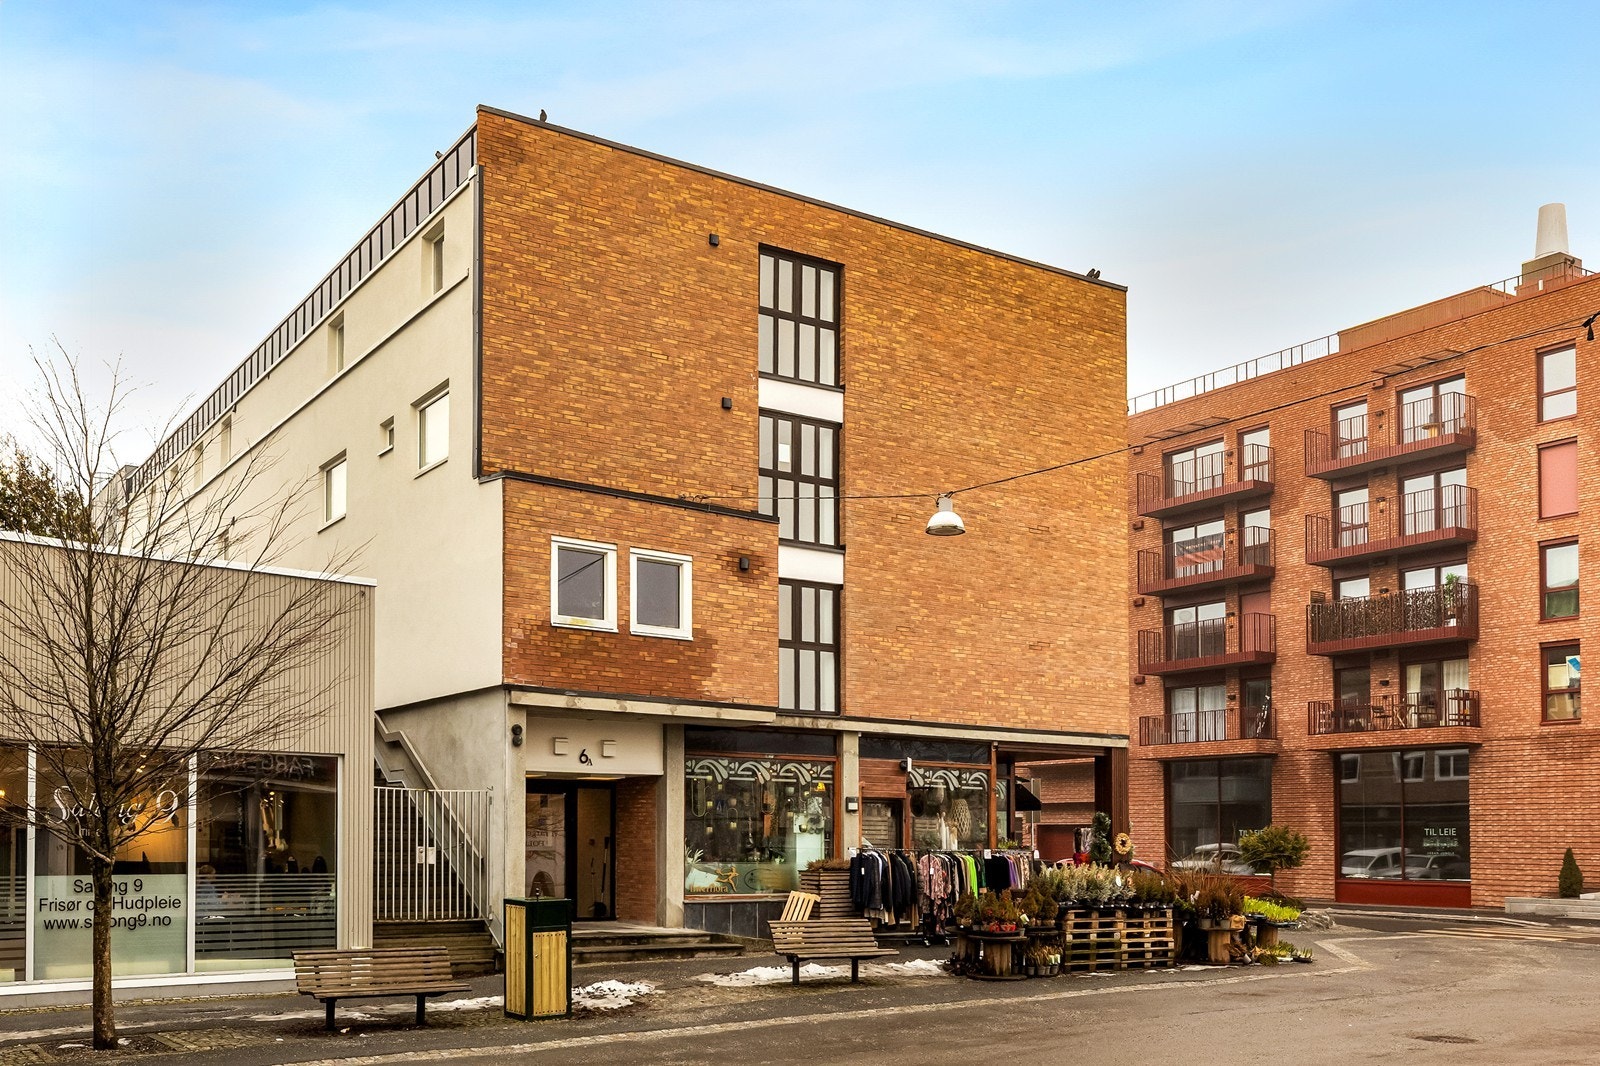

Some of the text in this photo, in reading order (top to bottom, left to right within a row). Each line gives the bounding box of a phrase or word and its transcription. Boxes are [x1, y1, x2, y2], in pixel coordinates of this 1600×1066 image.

[153, 789, 179, 825] 9
[1424, 828, 1457, 836] TIL LEIE
[73, 878, 143, 896] Sang 9
[39, 897, 82, 912] Frisør
[112, 896, 182, 912] Hudpleie
[44, 913, 172, 931] www.song9.no
